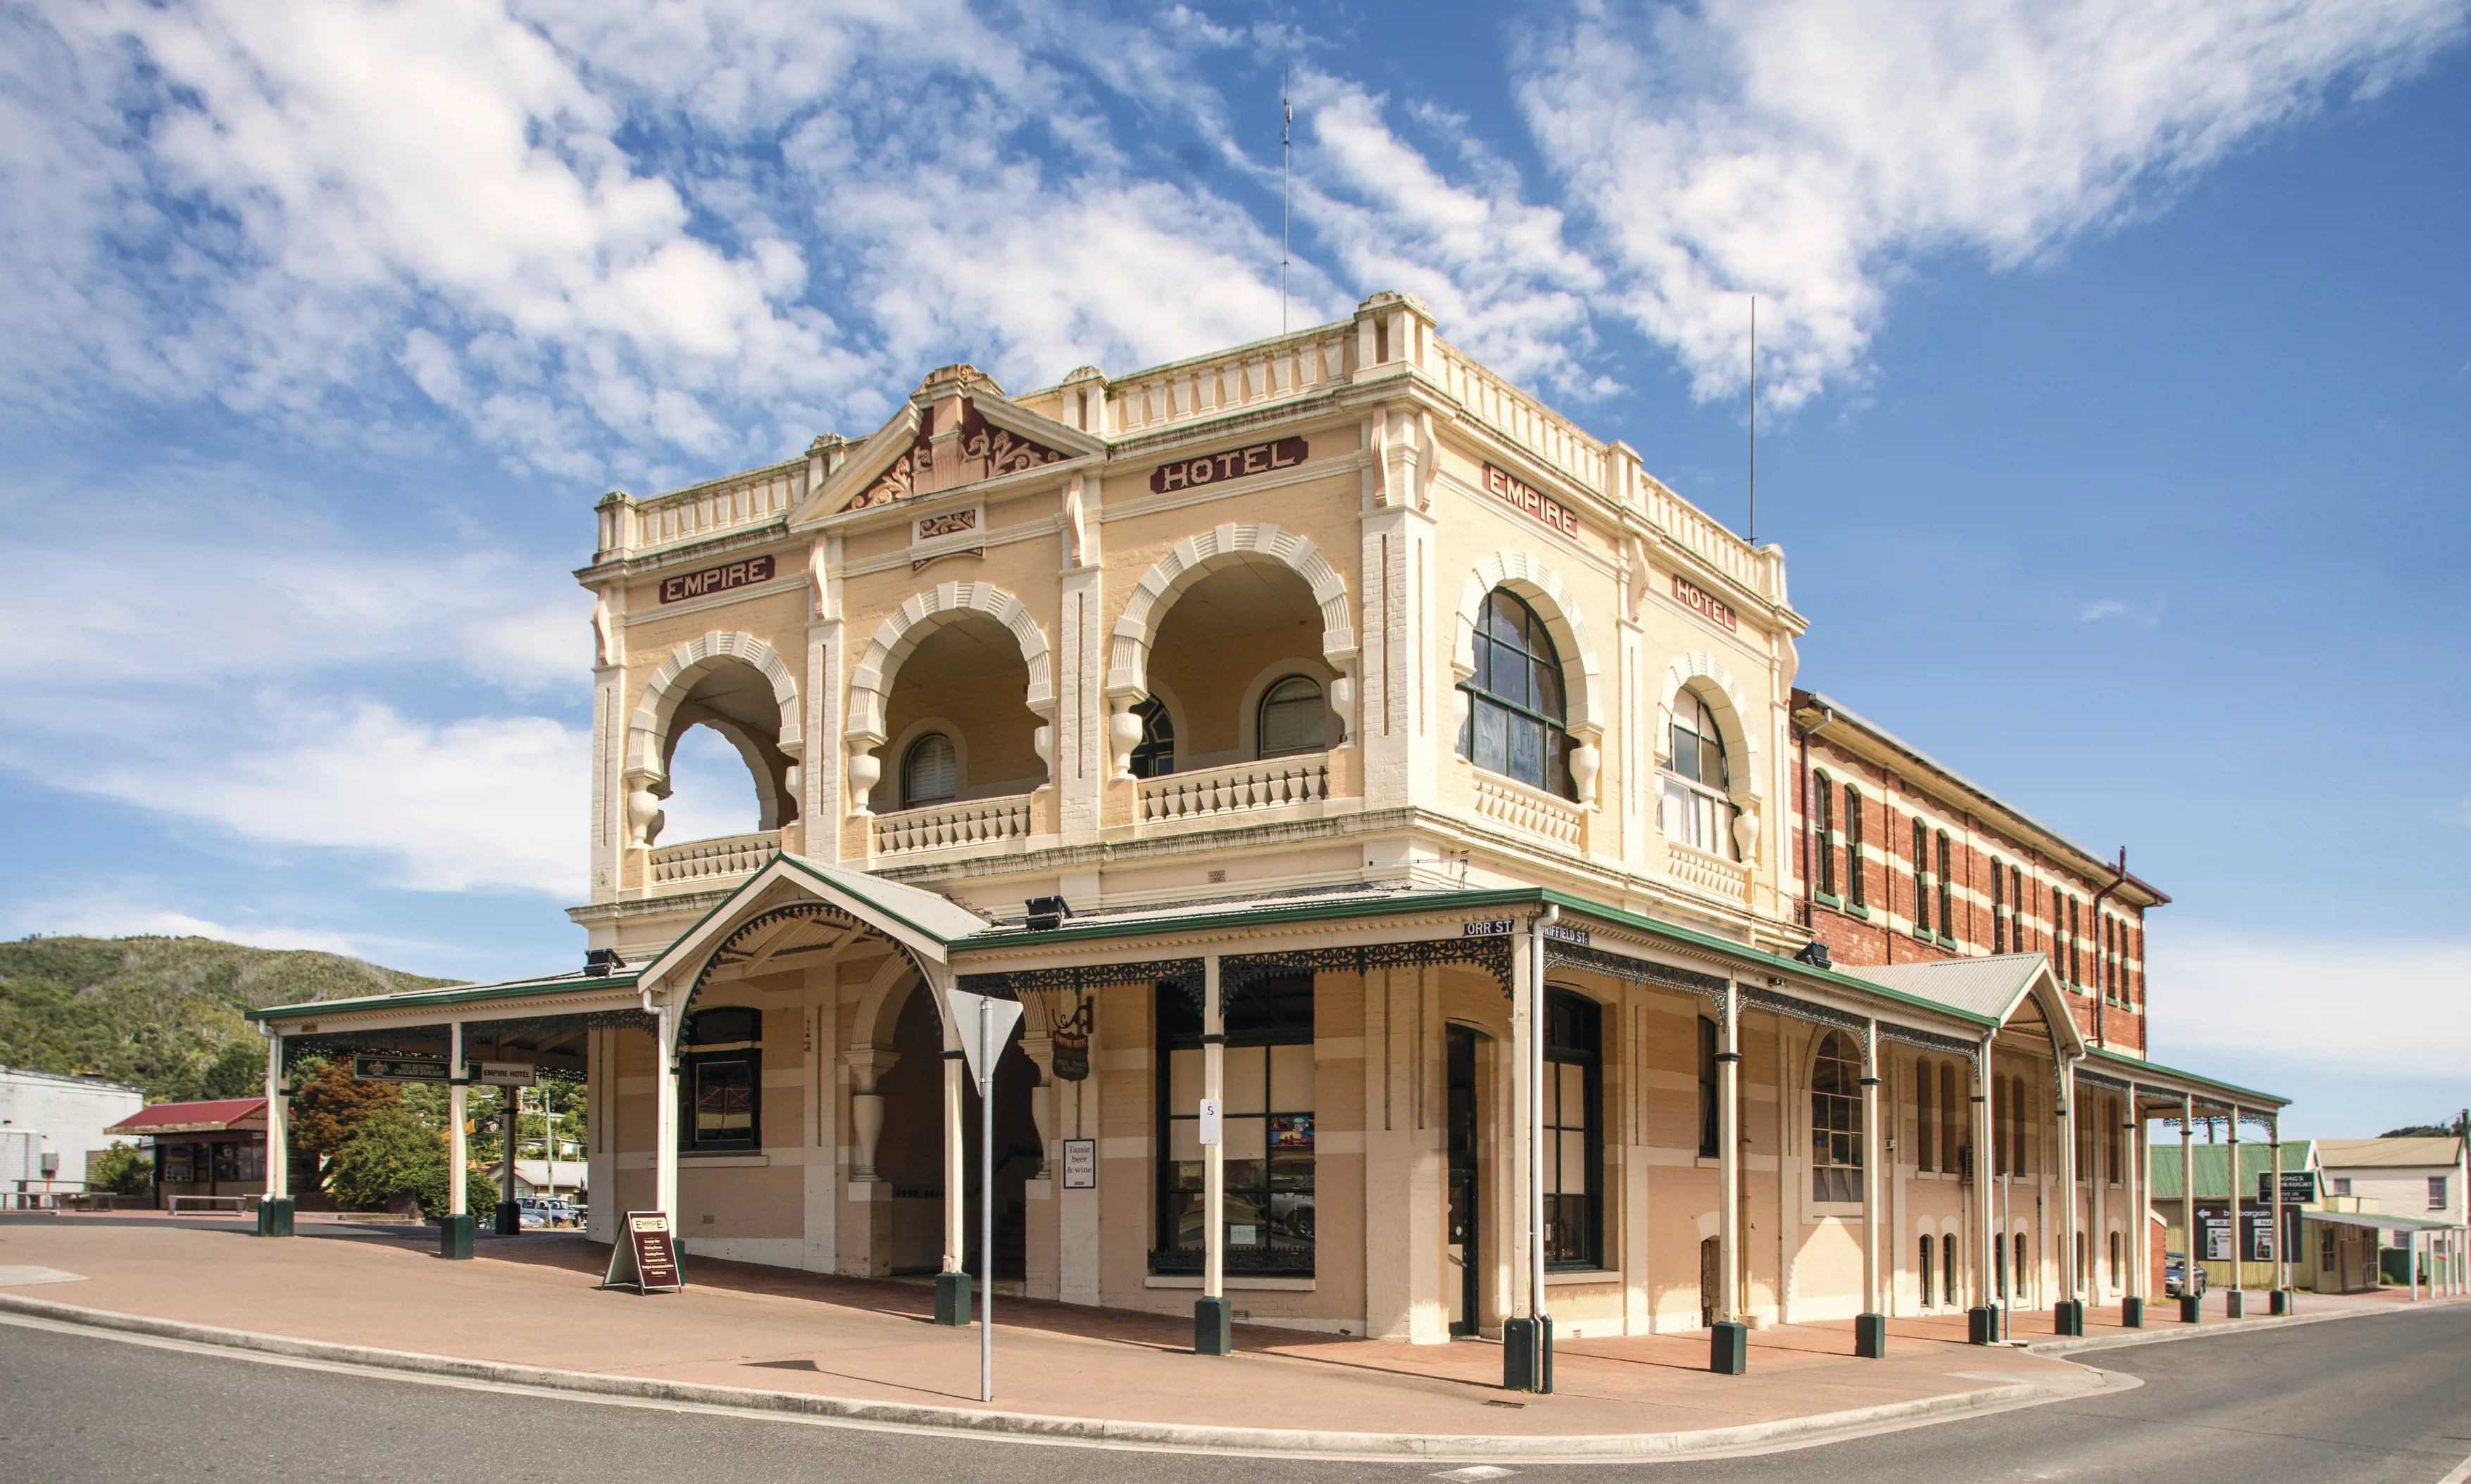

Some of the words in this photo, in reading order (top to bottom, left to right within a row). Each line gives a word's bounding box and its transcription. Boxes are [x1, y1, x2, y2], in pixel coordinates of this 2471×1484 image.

[1163, 442, 1296, 491] HOTEL
[1489, 465, 1577, 539] EMPIRE
[666, 557, 767, 601] EMPIRE
[1676, 577, 1734, 632] HOTEL
[1468, 922, 1491, 935] ORR
[1543, 924, 1575, 941] RIFFIELD
[636, 1220, 663, 1229] EMPIRE
